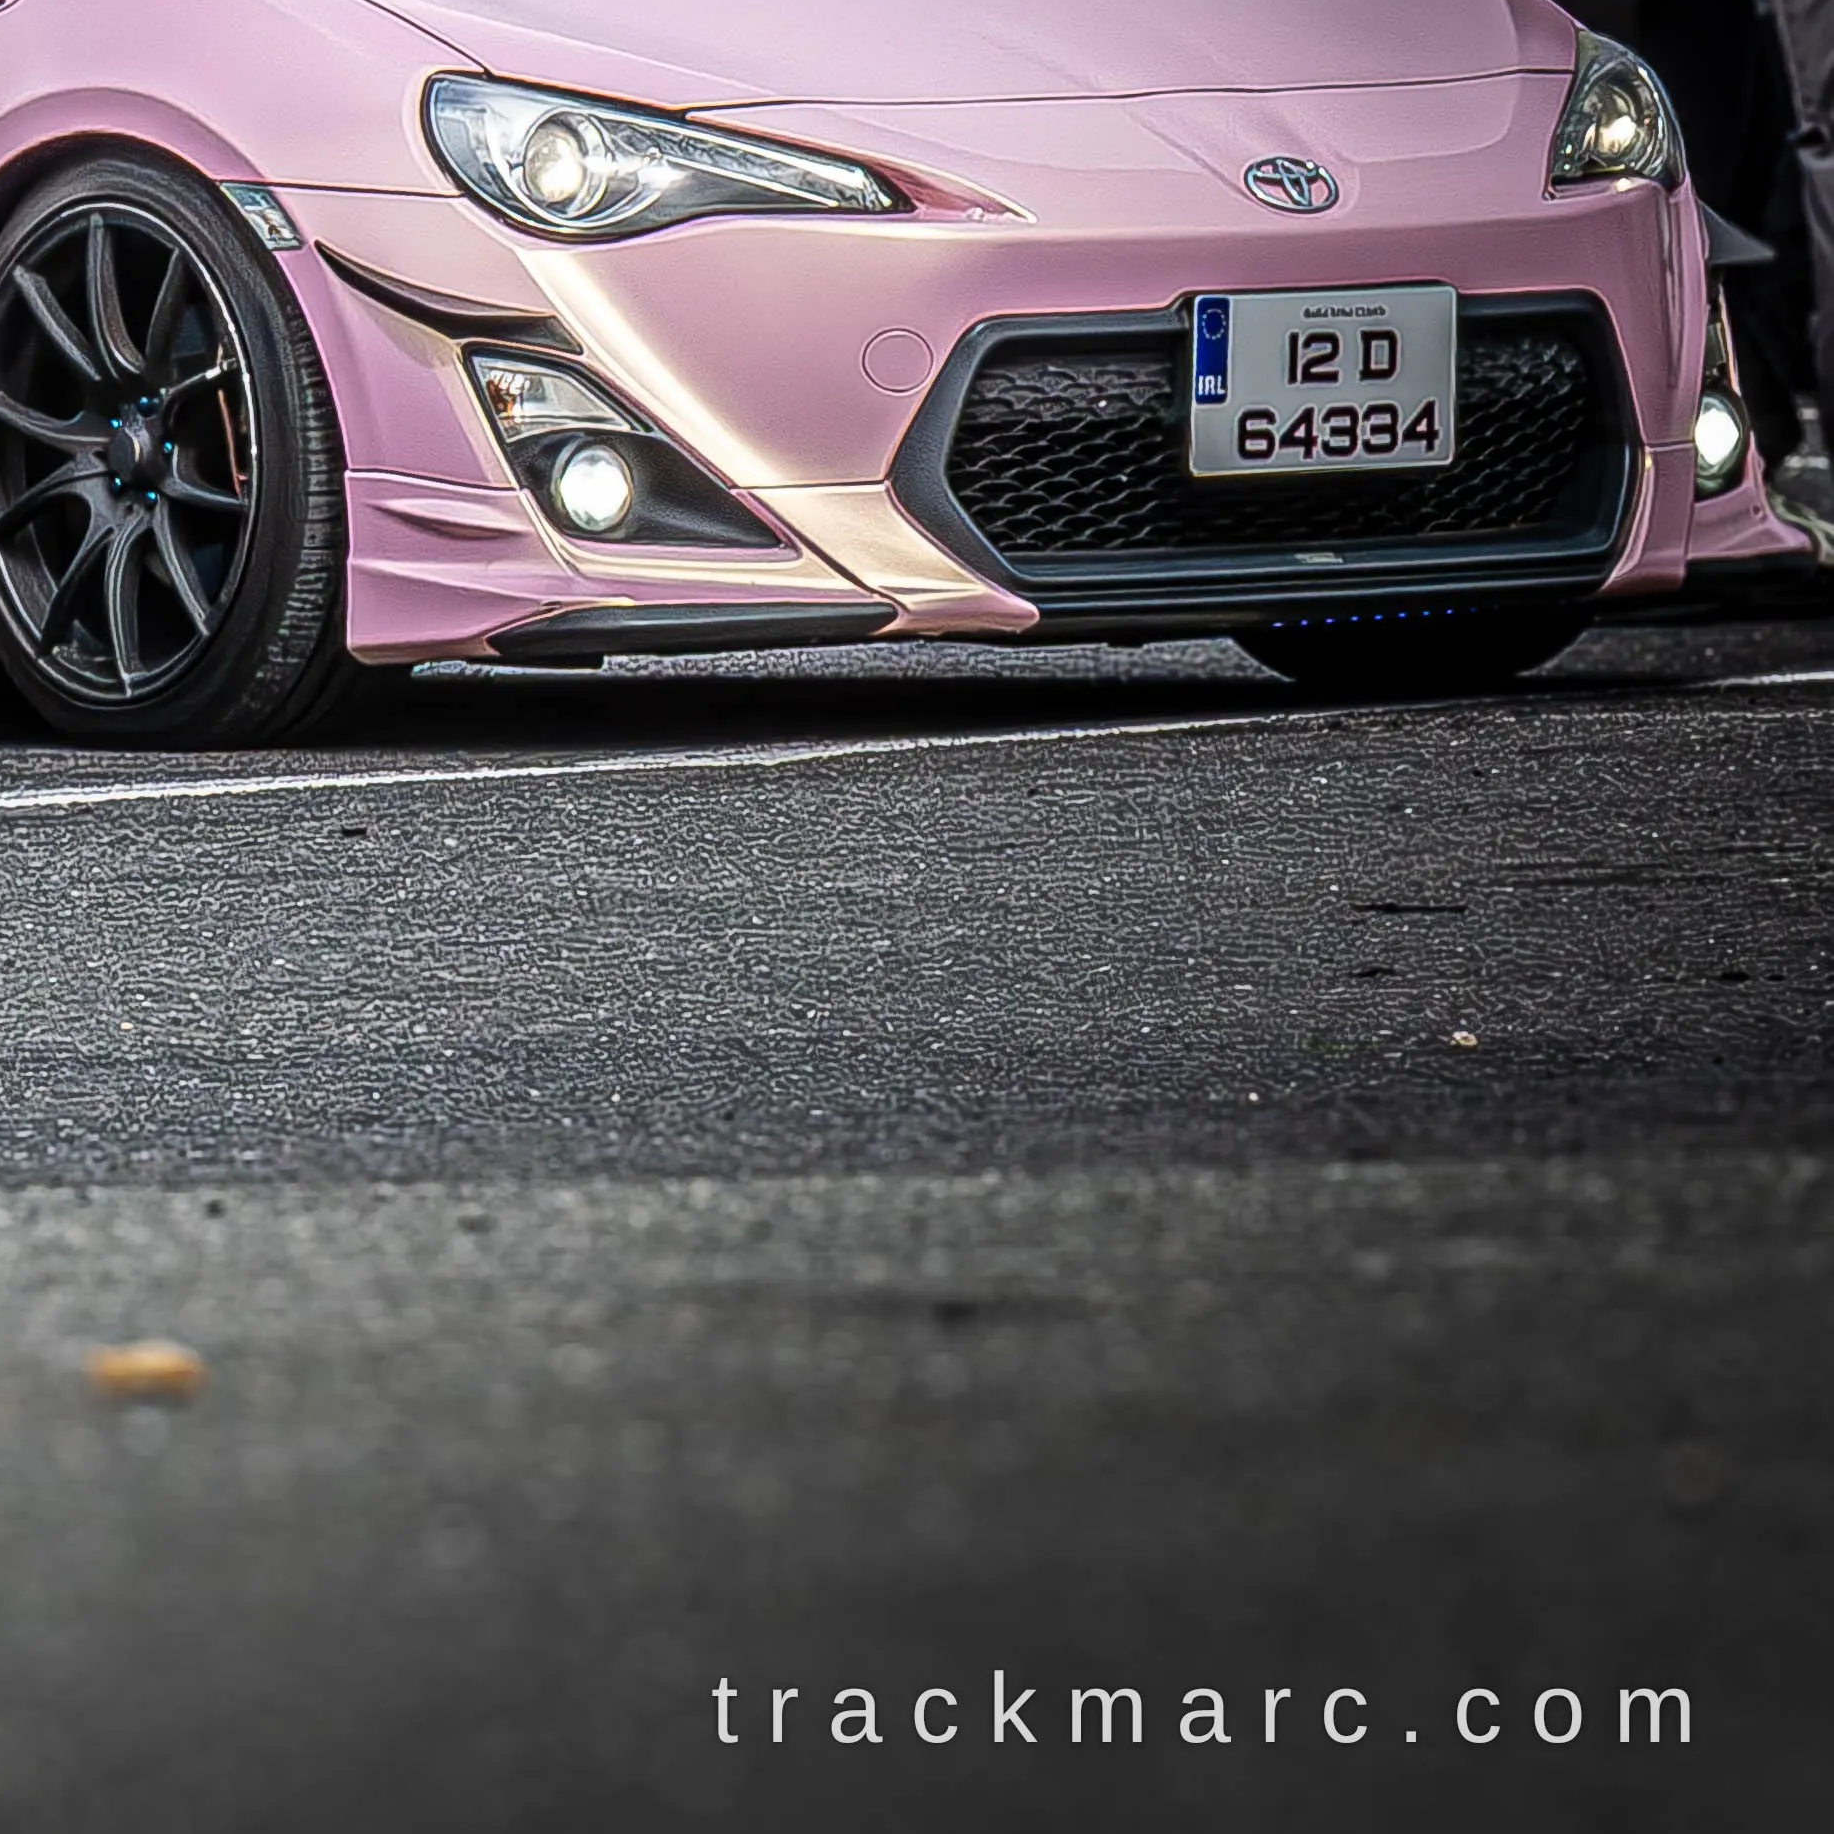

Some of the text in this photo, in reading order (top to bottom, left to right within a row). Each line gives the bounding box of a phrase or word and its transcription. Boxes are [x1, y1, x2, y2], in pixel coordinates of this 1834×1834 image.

[1288, 329, 1399, 385] 12 D
[1198, 375, 1227, 396] IRL
[1237, 399, 1440, 460] 64334
